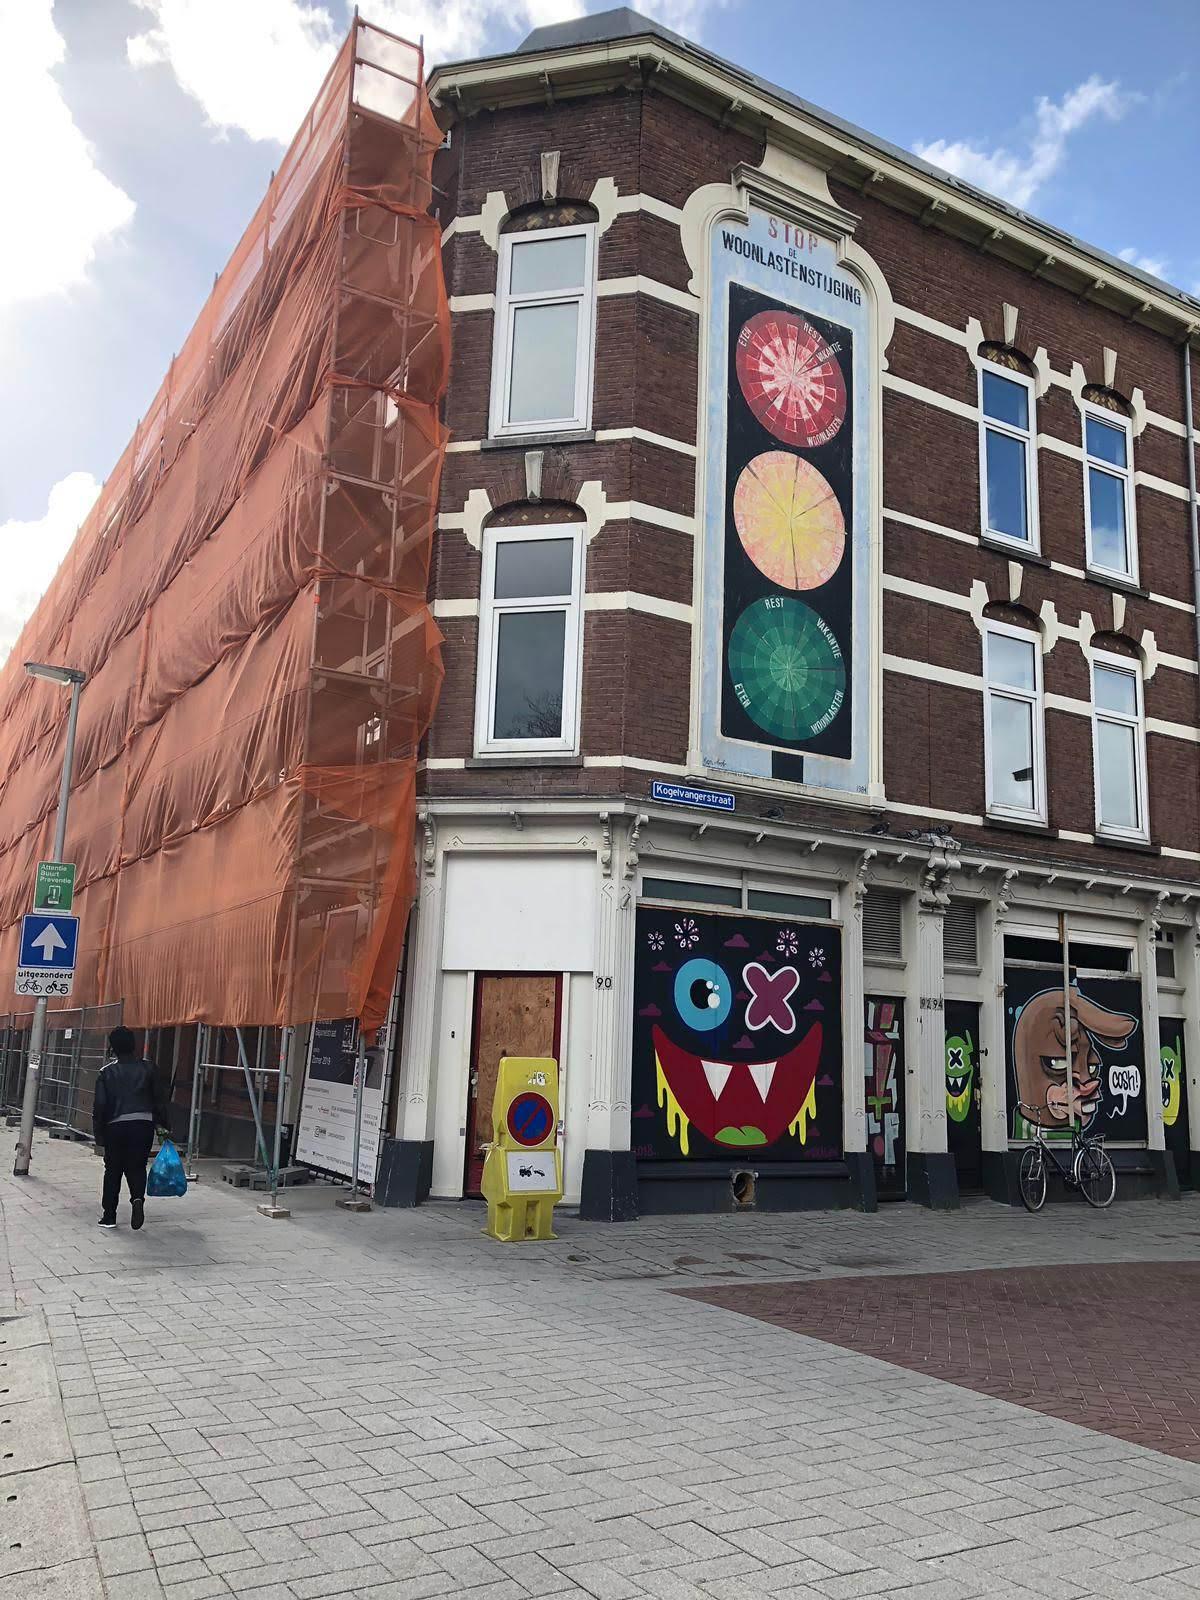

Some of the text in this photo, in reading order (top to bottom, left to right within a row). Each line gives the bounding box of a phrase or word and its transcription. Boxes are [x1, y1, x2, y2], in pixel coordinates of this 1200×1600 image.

[768, 216, 818, 254] STOP
[721, 230, 861, 306] WOONLASTENSTIJGING
[738, 326, 752, 347] ETEN
[803, 322, 824, 342] REST
[807, 415, 842, 447] WOONLASTEN
[765, 597, 784, 610] REST
[816, 618, 842, 659] VAKANTIE
[734, 683, 751, 708] ETEN
[810, 690, 844, 735] WOONLASTEN
[656, 784, 732, 805] Kogelvangerstraat
[41, 864, 67, 872] Attentie
[40, 876, 71, 884] Preventie
[18, 970, 72, 979] uitgezonderd
[597, 977, 611, 988] 90
[921, 998, 943, 1009] 92 94
